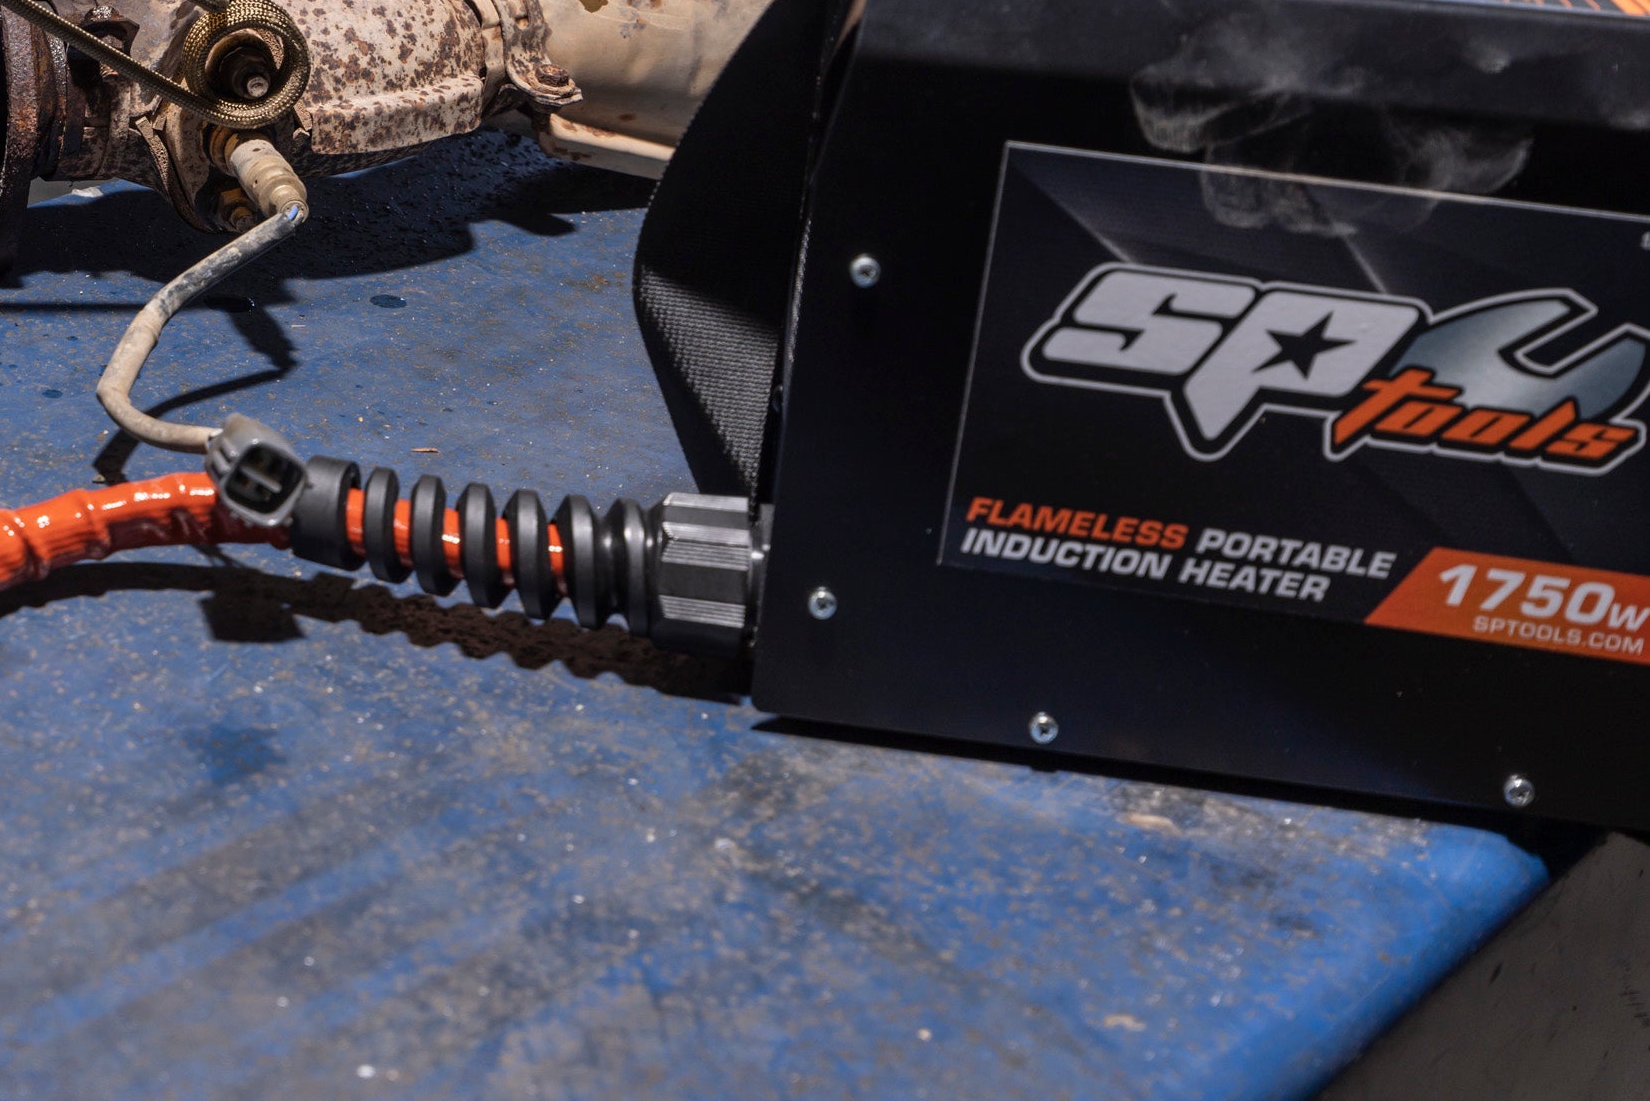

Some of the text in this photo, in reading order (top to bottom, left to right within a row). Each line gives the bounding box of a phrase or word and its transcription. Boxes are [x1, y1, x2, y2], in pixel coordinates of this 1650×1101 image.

[1036, 266, 1422, 445] SP
[960, 527, 1331, 603] INDUCTION HEATER
[966, 496, 1397, 580] FLAMELESS PORTABLE
[1472, 614, 1645, 656] SPTOOLS.COM
